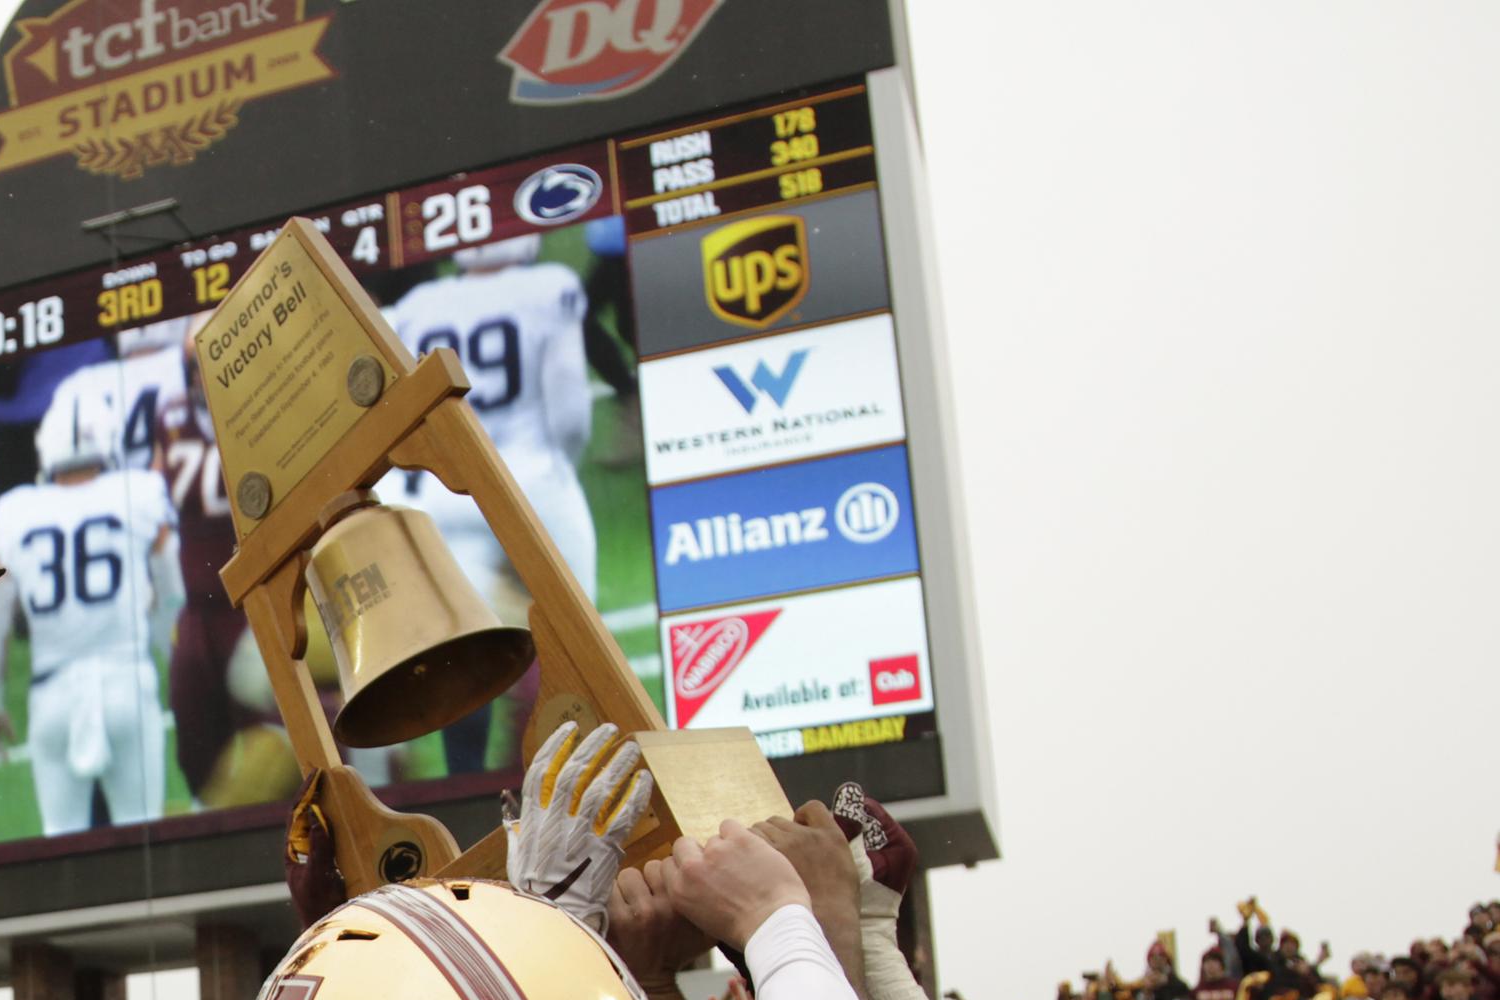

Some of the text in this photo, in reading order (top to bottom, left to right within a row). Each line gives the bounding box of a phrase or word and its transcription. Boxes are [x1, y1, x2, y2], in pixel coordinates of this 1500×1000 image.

[62, 0, 278, 79] tcf bank
[540, 0, 678, 74] DQ
[58, 53, 258, 139] STADIUM
[650, 130, 712, 167] RUSH
[653, 158, 715, 194] PASS
[341, 203, 384, 227] QTR
[421, 185, 492, 251] 26
[653, 191, 721, 227] TOTAL
[181, 241, 238, 268] TO GO
[352, 226, 381, 264] 4
[102, 262, 158, 289] DOWN
[192, 263, 230, 303] 12
[713, 244, 802, 314] ups
[97, 277, 163, 328] 3RD
[209, 260, 293, 361] Governor's
[217, 281, 307, 389] Victory Bell
[655, 403, 884, 455] WESTERN NATIONAL
[664, 507, 829, 565] Allianz
[21, 514, 123, 614] 36
[741, 679, 833, 712] Available
